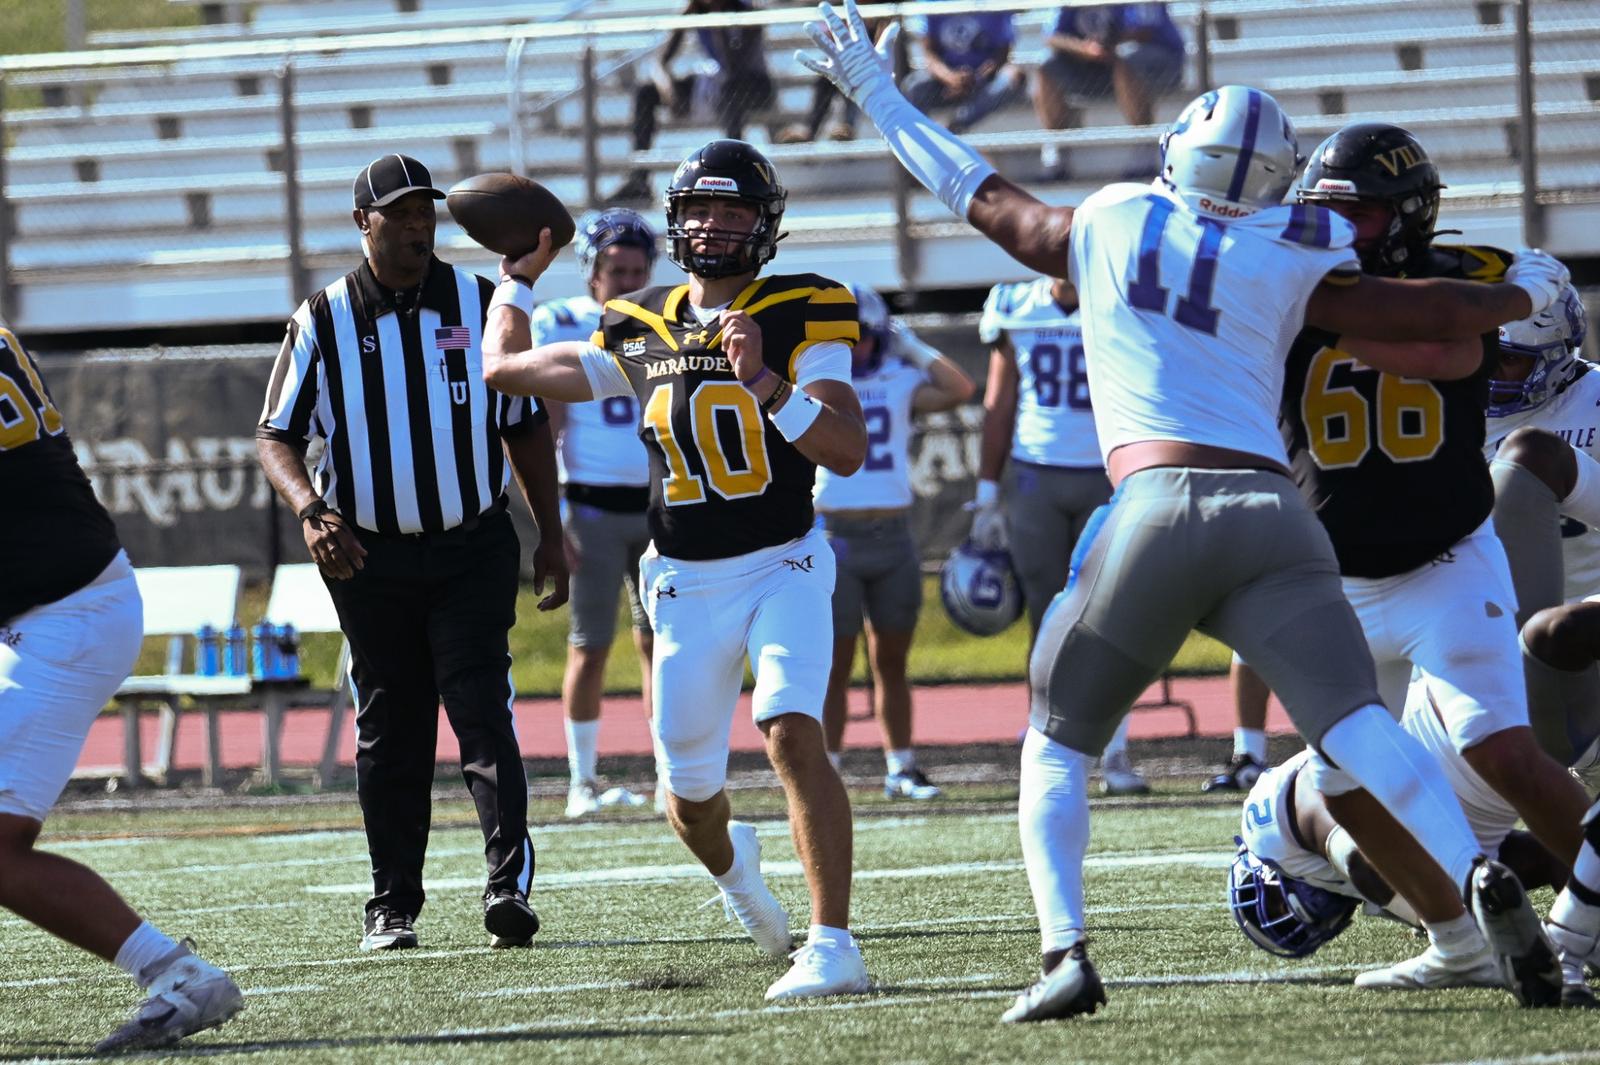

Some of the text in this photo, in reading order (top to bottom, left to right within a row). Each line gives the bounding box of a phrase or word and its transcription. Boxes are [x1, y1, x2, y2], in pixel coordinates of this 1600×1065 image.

[701, 179, 733, 187] Riddell
[1200, 198, 1257, 218] Ridde
[1127, 194, 1228, 337] 11
[362, 335, 377, 353] S
[623, 340, 646, 353] PSAC
[645, 356, 735, 380] MARAUDE
[1031, 344, 1094, 408] 88
[450, 381, 467, 405] U
[1301, 346, 1445, 470] 66
[643, 379, 773, 507] 10
[1246, 798, 1273, 831] 2
